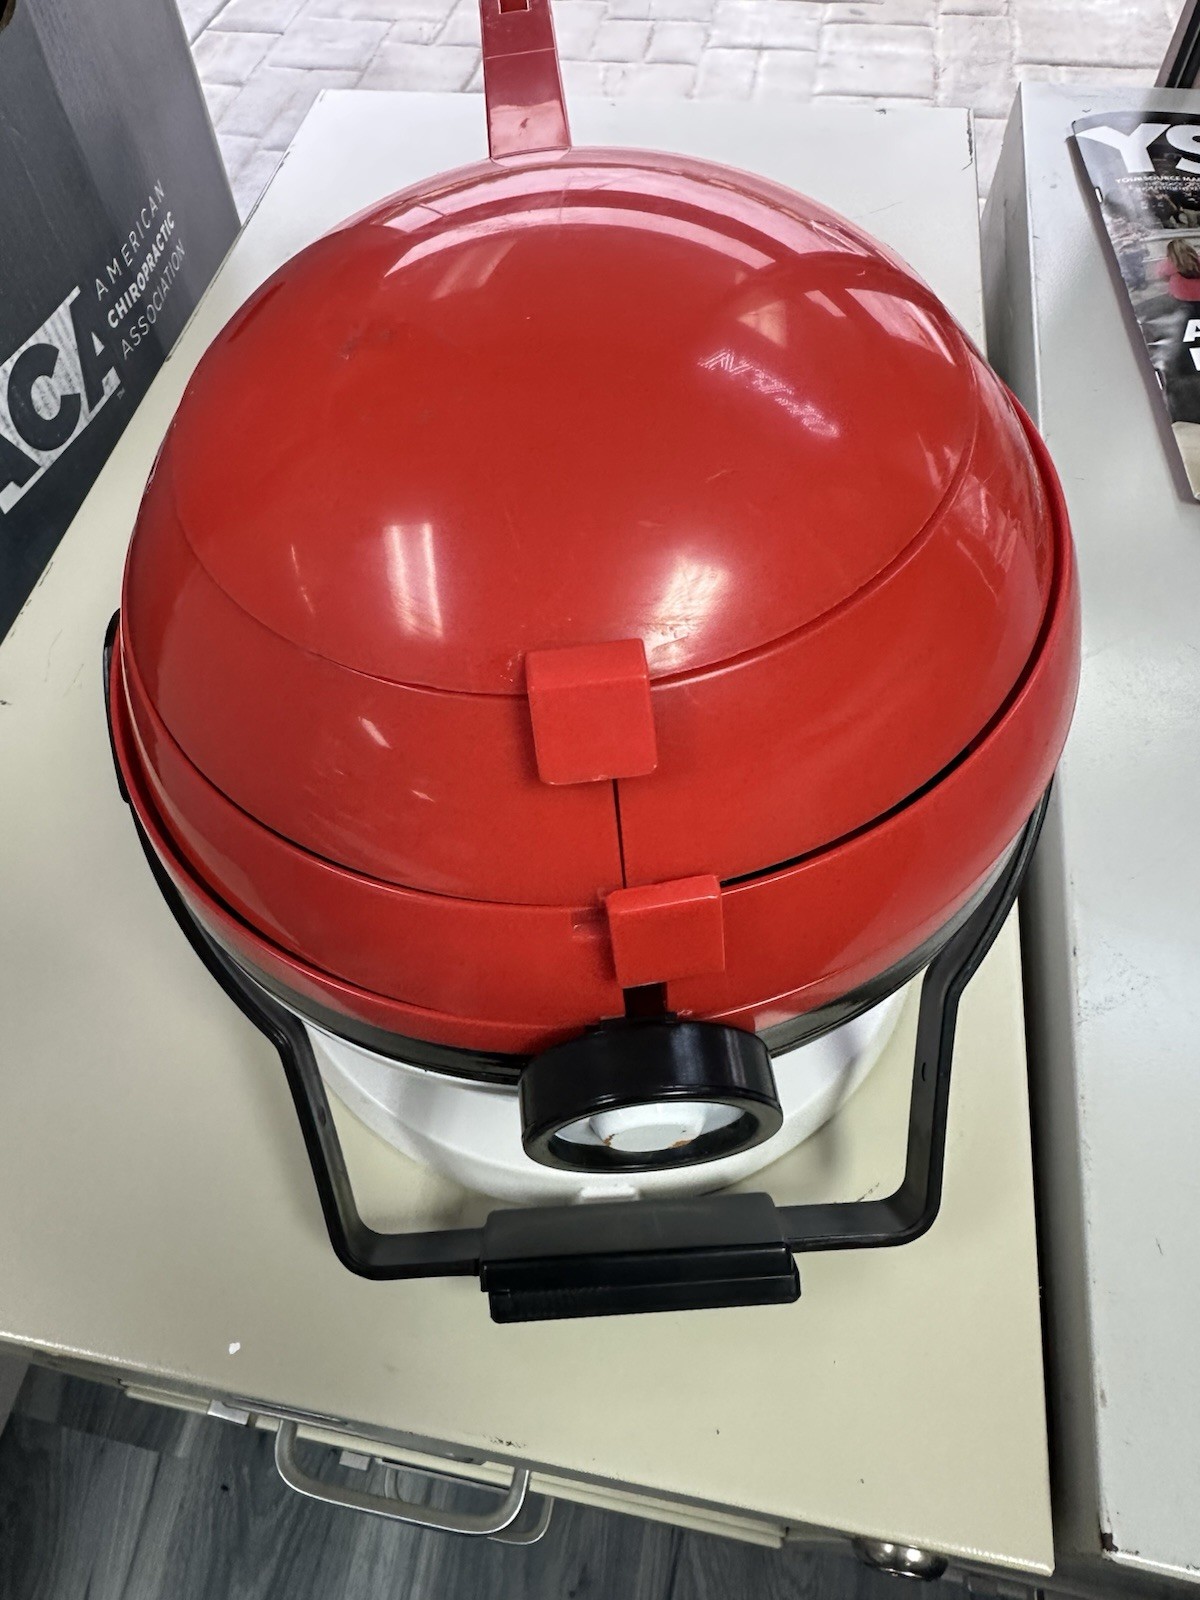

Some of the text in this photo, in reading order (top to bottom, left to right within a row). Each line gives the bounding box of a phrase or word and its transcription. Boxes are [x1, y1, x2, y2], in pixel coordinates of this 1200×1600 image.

[95, 178, 165, 301] AMERICAN
[107, 211, 175, 329] CHIROPRACTIC
[122, 238, 186, 360] ASSOCIATION
